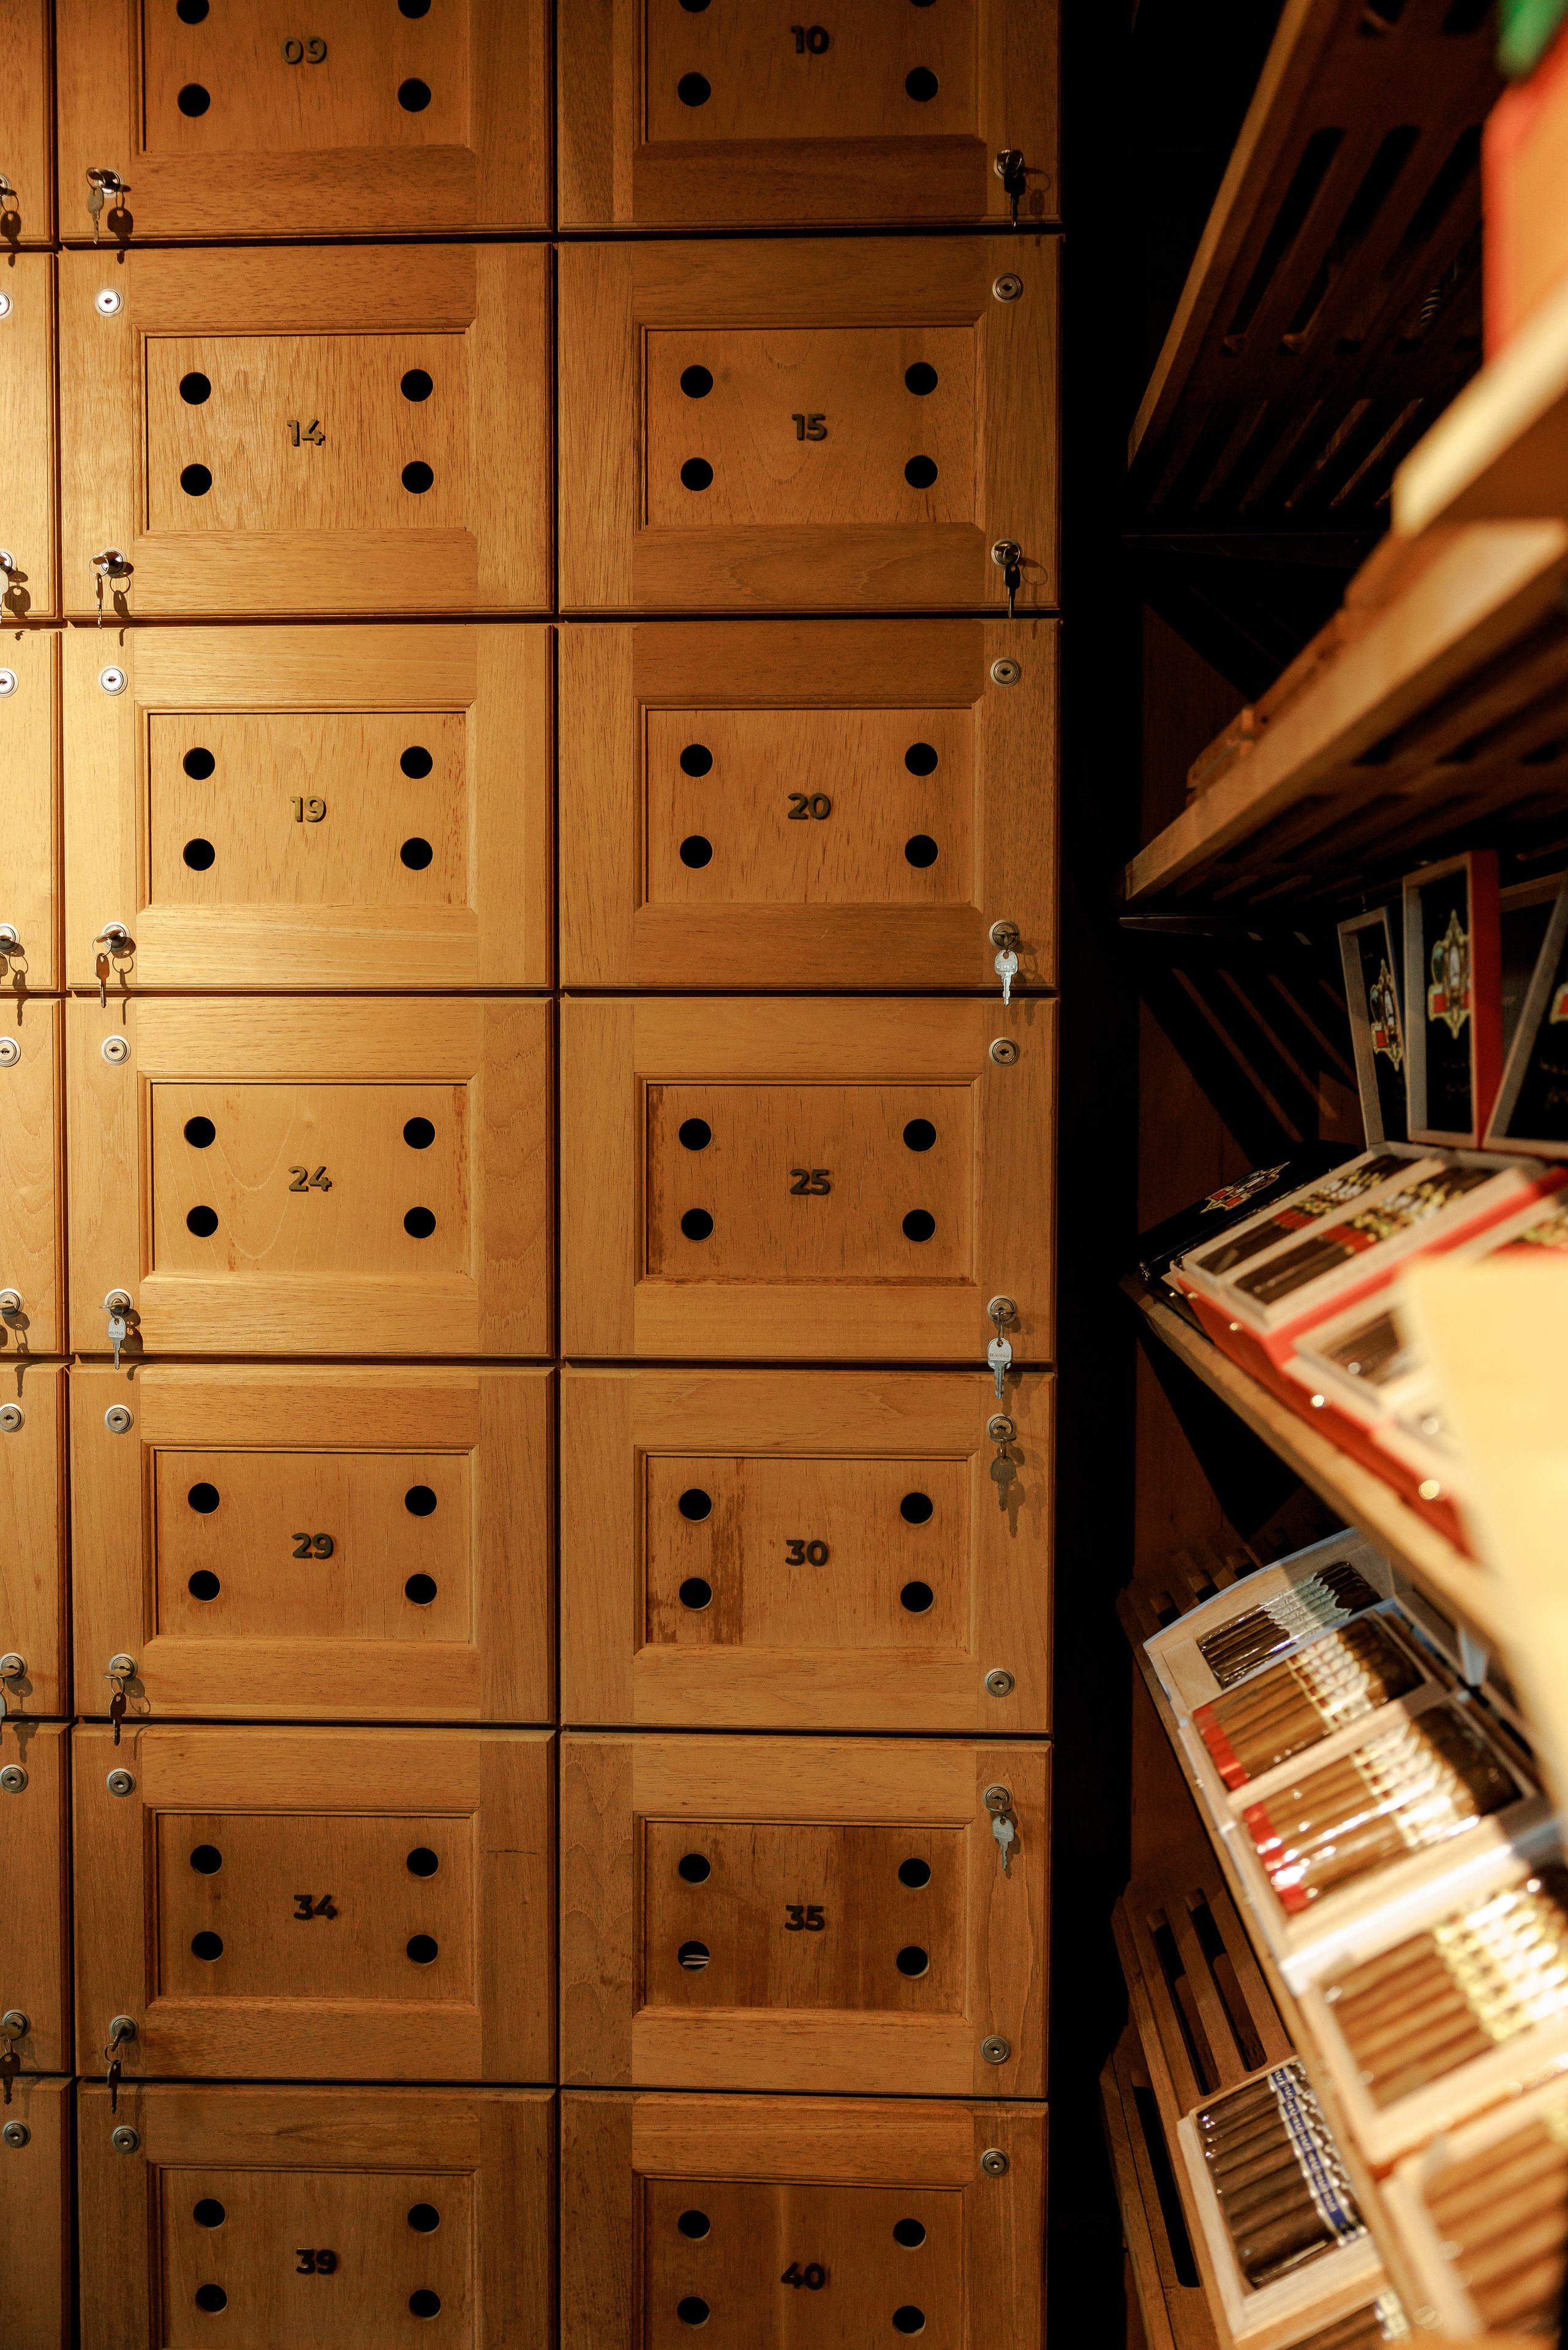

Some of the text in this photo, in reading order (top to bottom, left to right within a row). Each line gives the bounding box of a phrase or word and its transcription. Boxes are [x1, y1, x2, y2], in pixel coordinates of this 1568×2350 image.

[281, 37, 327, 64] 09
[791, 26, 829, 54] 10
[287, 420, 325, 446] 14
[793, 414, 827, 441] 15
[290, 796, 326, 823] 19
[788, 793, 831, 821] 20
[289, 1166, 332, 1192] 24
[790, 1169, 831, 1196] 25
[292, 1533, 334, 1559] 29
[785, 1539, 829, 1566] 30
[294, 1895, 337, 1921] 34
[785, 1905, 825, 1932] 35
[296, 2248, 337, 2275] 39
[781, 2262, 826, 2290] 40
